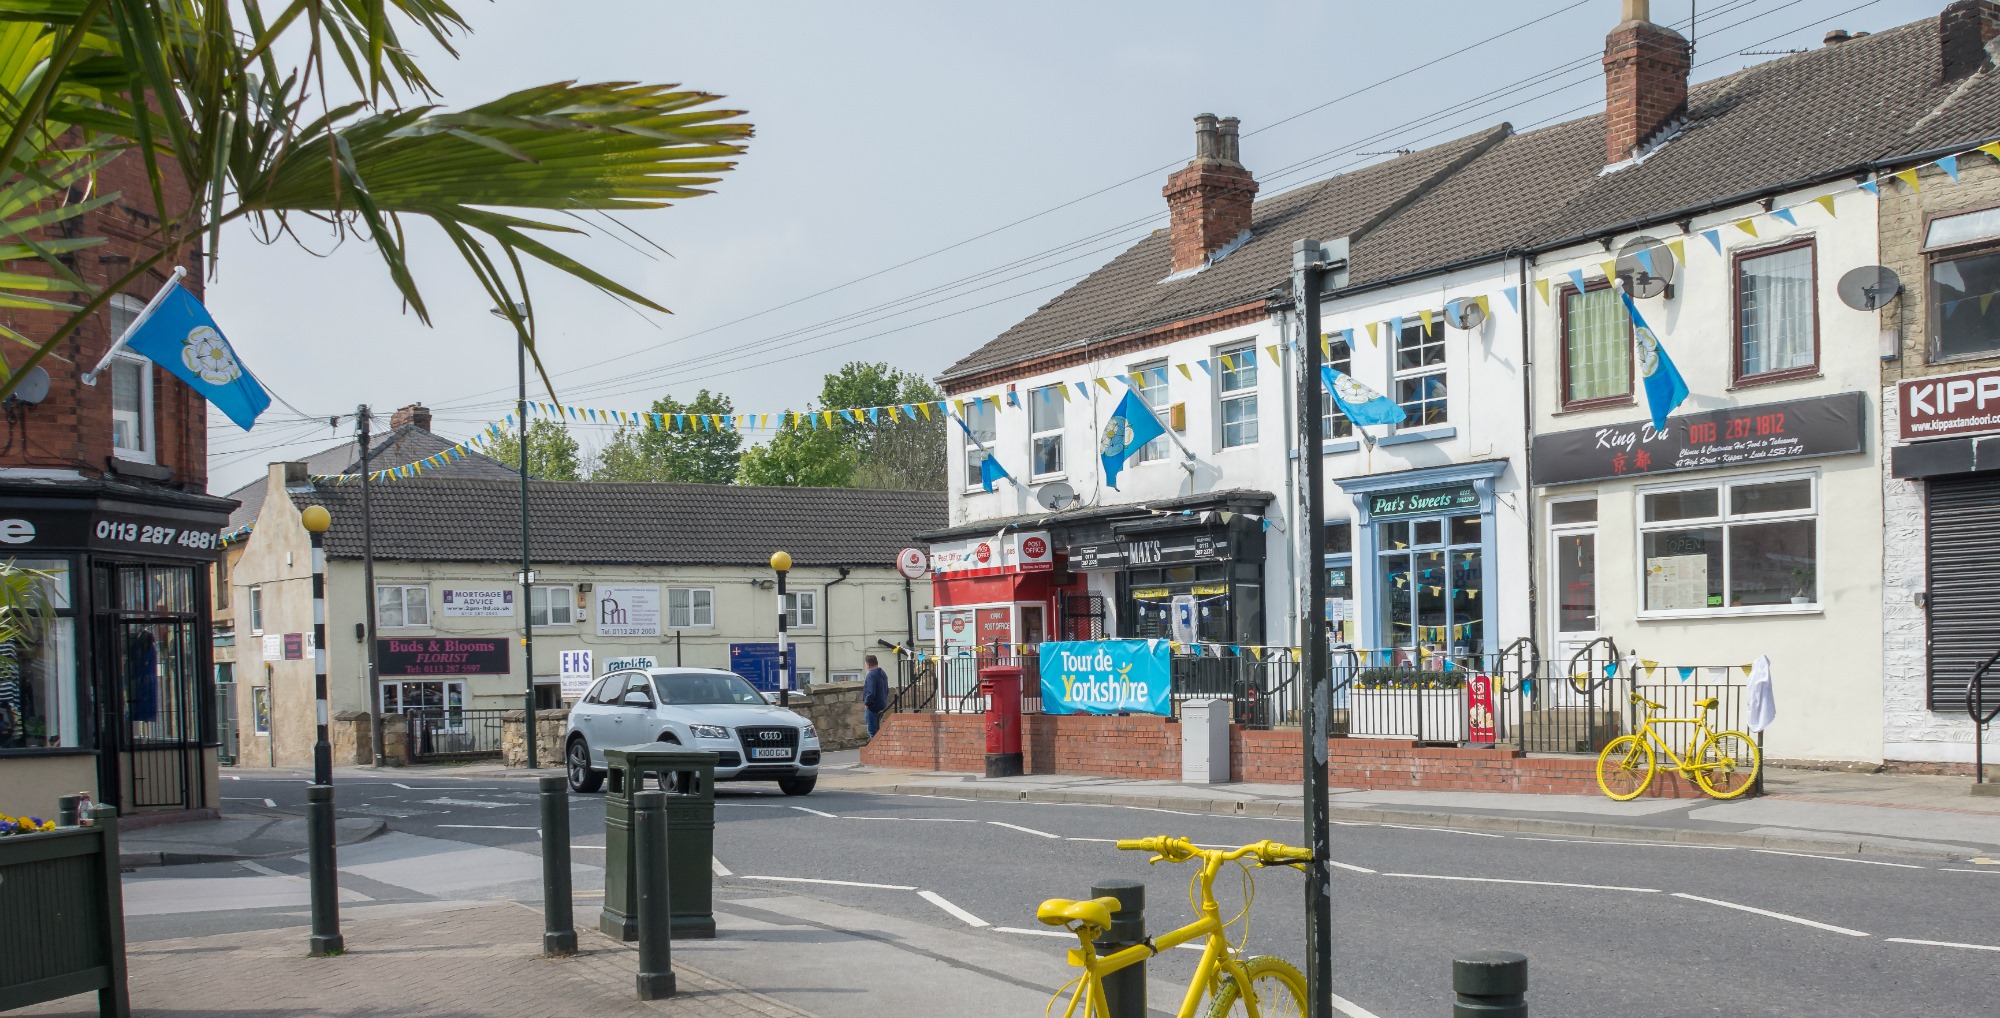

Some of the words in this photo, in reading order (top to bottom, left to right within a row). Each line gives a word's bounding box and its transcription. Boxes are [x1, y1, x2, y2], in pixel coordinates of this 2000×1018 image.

[1689, 422, 1717, 444] 0113
[1725, 417, 1752, 439] 287
[1756, 413, 1785, 436] 1812
[1595, 428, 1637, 452] King
[1642, 421, 1669, 443] Du
[1746, 440, 1761, 449] Food
[1769, 436, 1799, 446] Takeaway
[1684, 457, 1699, 467] High
[1699, 455, 1717, 465] Street
[1374, 496, 1405, 513] Pat's
[1408, 493, 1452, 510] Sweets
[97, 520, 137, 541] 0113
[140, 525, 176, 544] 287
[178, 530, 218, 549] 4881
[1025, 546, 1045, 554] OFFICE
[1668, 538, 1701, 551] OPEN
[938, 554, 948, 562] Post
[1129, 540, 1161, 564] MAX'S
[389, 640, 424, 652] Buds
[428, 640, 441, 652] &
[444, 640, 495, 652] Blooms
[416, 653, 469, 663] FLORIST
[608, 657, 652, 672] ratcliffe
[1061, 651, 1092, 672] Tour
[1094, 649, 1113, 672] de
[424, 664, 444, 673] 0113
[445, 664, 459, 672] 287
[1062, 674, 1148, 704] Yorkshire
